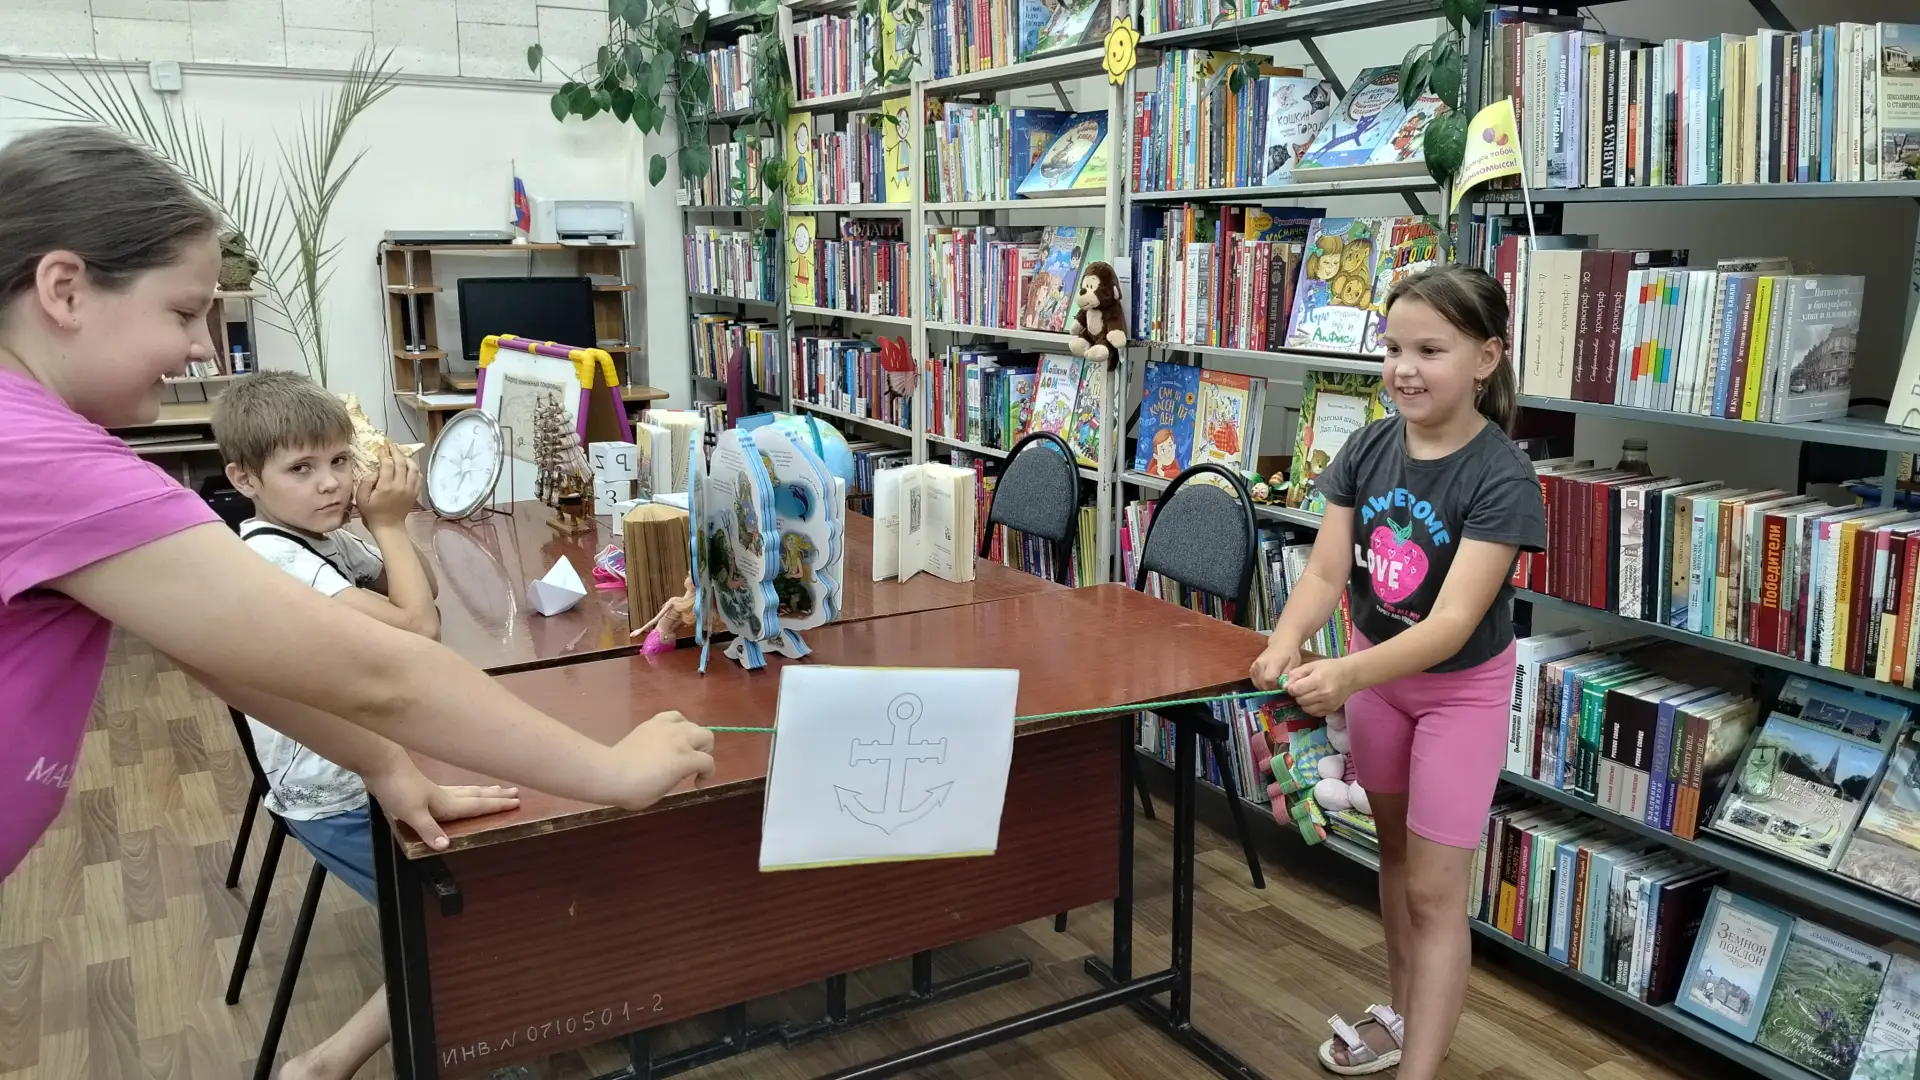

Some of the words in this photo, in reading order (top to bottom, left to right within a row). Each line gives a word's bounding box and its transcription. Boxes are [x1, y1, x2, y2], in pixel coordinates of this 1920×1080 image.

[1559, 53, 1568, 105] СТАВРОПОЛЬЯ
[1277, 110, 1310, 126] КОШКИН
[1553, 109, 1561, 148] ИСТОРИЯ
[1602, 123, 1616, 180] КАВКАЗ
[851, 222, 899, 238] ФЛАГИ
[1537, 288, 1547, 330] хронограф
[1728, 283, 1737, 307] КАНАЛА
[1302, 301, 1330, 326] Про
[1561, 290, 1572, 331] хронограф
[1579, 293, 1591, 334] хронограф
[1595, 291, 1606, 333] хронограф
[1611, 292, 1624, 334] хронограф
[1741, 310, 1750, 331] живой
[1723, 309, 1734, 345] МОЛОДОСТЬ
[1720, 348, 1730, 371] ВТОРАЯ
[1738, 332, 1747, 357] истоков
[504, 374, 517, 384] Карта
[517, 378, 539, 389] книжных
[1355, 544, 1403, 590] LOVE
[1763, 524, 1781, 609] Победители
[1841, 540, 1850, 580] СТАВРОПОЛЬЕ
[1511, 664, 1527, 713] Исповедь
[1613, 721, 1621, 740] СОЛНЦЕ
[1637, 730, 1645, 748] СОЛНЦЕ
[1610, 740, 1618, 759] РУССКОЕ
[1634, 748, 1642, 767] РУССКОЕ
[1683, 751, 1692, 773] СВЕТУ
[1694, 755, 1703, 776] СВЕТУ
[1647, 780, 1657, 820] ВЛАДИМИР
[1653, 782, 1663, 823] МАЛЯРОВ
[1667, 783, 1675, 805] МАЛЯРОВ
[1664, 805, 1672, 826] ВЛАДИМИР
[1511, 846, 1520, 883] ПИСАТЕЛИ
[1520, 845, 1528, 875] СТАВРОПОЛЬЯ
[1560, 856, 1569, 886] ПОКЛОН
[1516, 897, 1525, 926] СОВРЕМЕННЫЕ
[1558, 887, 1568, 916] ЗЕМНОЙ
[1717, 922, 1768, 956] ЗЕМНОЙ
[1719, 940, 1764, 967] ПОКЛОН
[526, 993, 665, 1043] 0710501-2
